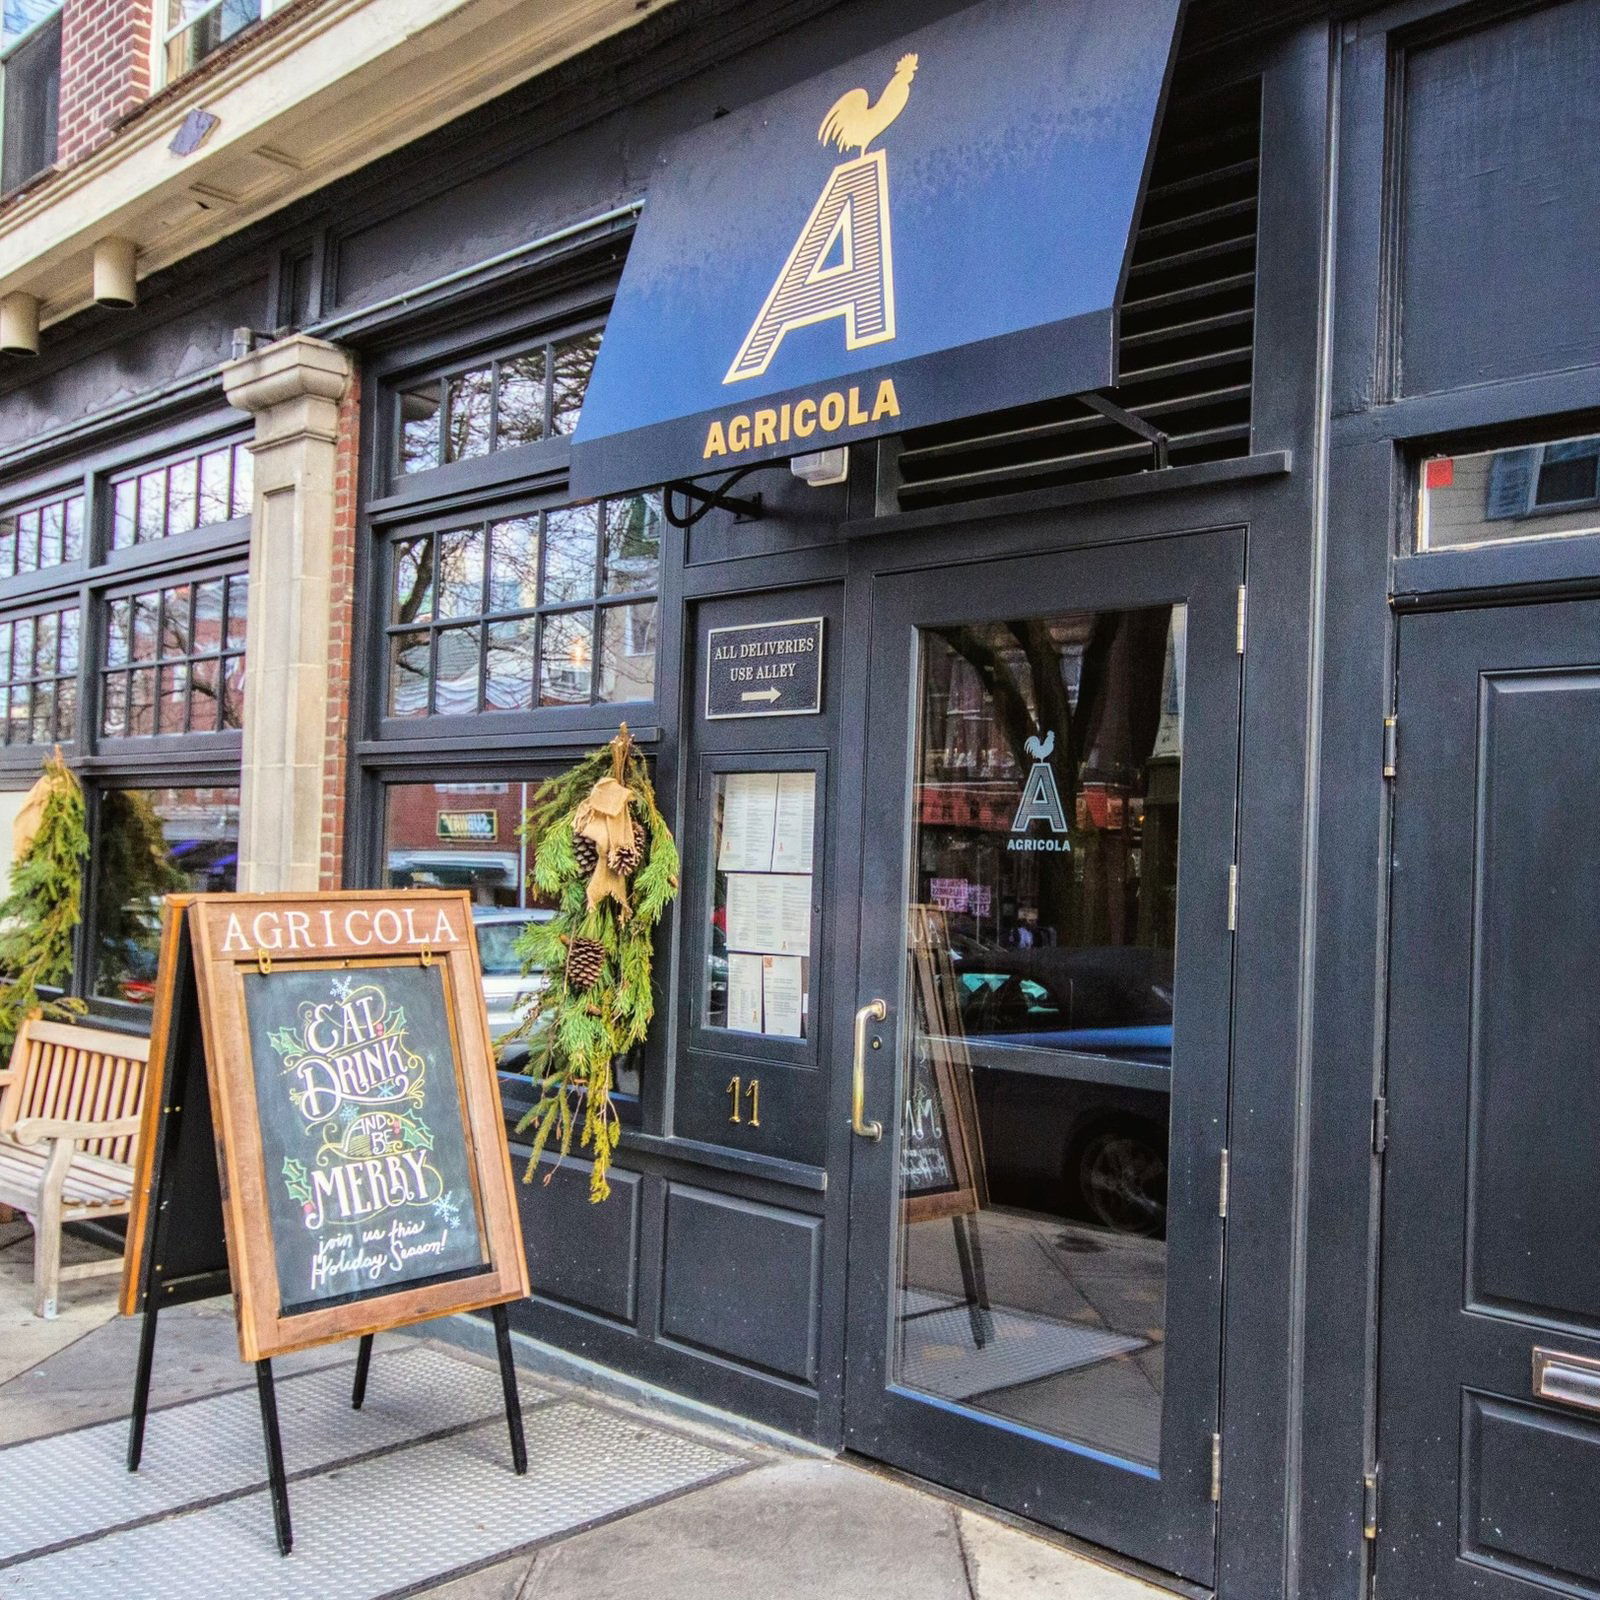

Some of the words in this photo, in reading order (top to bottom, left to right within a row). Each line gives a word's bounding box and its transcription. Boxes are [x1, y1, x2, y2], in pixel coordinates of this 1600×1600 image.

[722, 149, 896, 384] A
[703, 378, 900, 459] AGRICOLA
[715, 646, 737, 660] ALL
[740, 637, 814, 658] DELIVERIES
[730, 666, 753, 681] USE
[756, 663, 796, 679] ALLEY
[1011, 763, 1068, 832] A
[1007, 839, 1071, 851] AGRICOLA
[221, 908, 459, 952] AGRICOLA
[307, 996, 377, 1054] EAT
[297, 1036, 410, 1121] DRINK
[726, 1075, 760, 1127] 11
[346, 1114, 386, 1140] AND
[371, 1129, 394, 1155] BE
[305, 1150, 429, 1230] MERRY
[362, 1230, 385, 1243] us
[388, 1219, 425, 1245] this
[311, 1250, 387, 1290] Holiday
[389, 1229, 448, 1271] Season!
